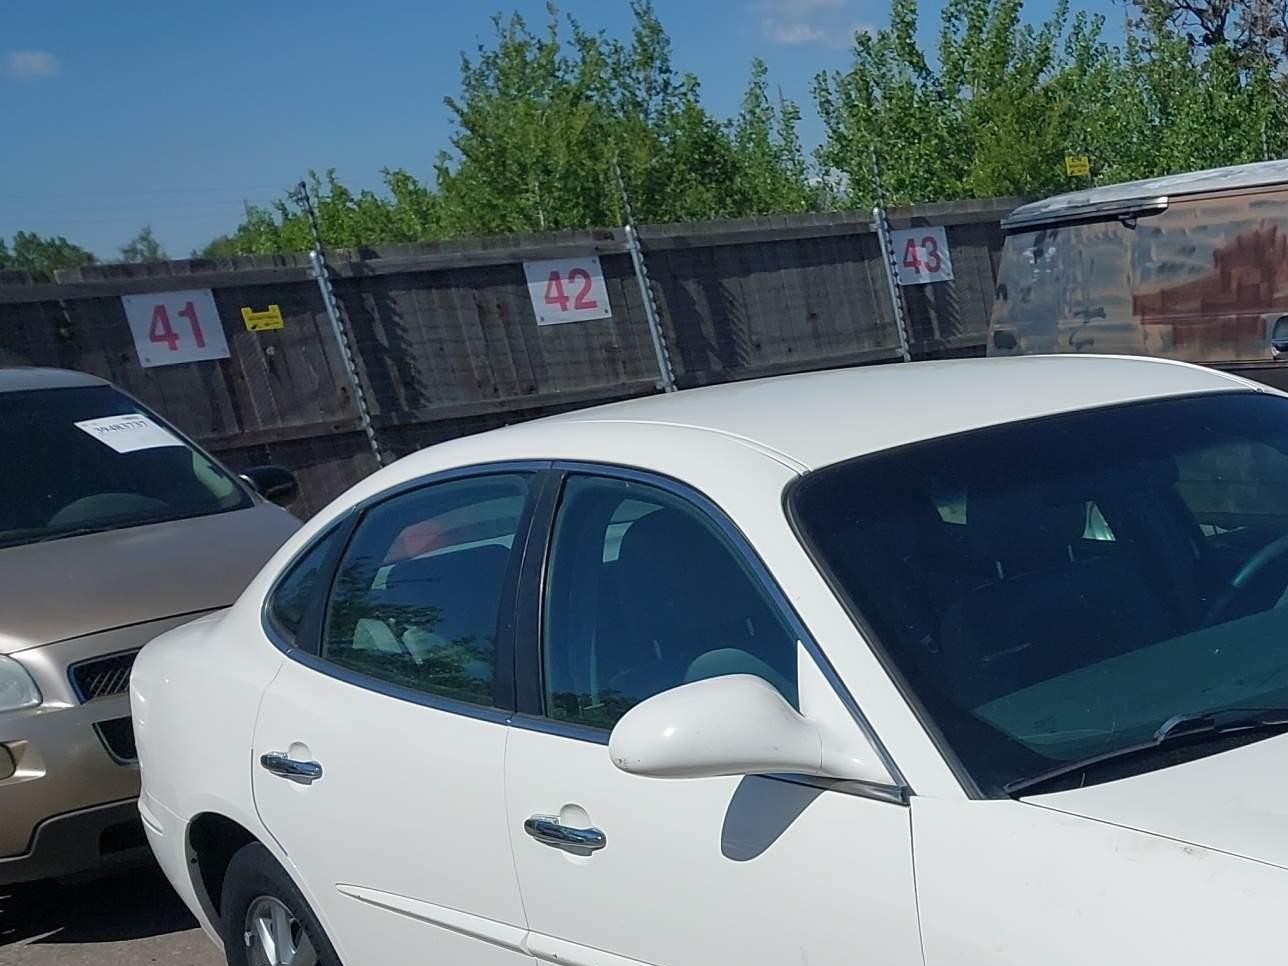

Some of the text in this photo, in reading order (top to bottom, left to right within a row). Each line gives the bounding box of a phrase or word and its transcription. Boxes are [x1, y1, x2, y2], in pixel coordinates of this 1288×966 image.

[903, 236, 942, 274] 43
[544, 267, 598, 312] 42
[149, 301, 206, 351] 41
